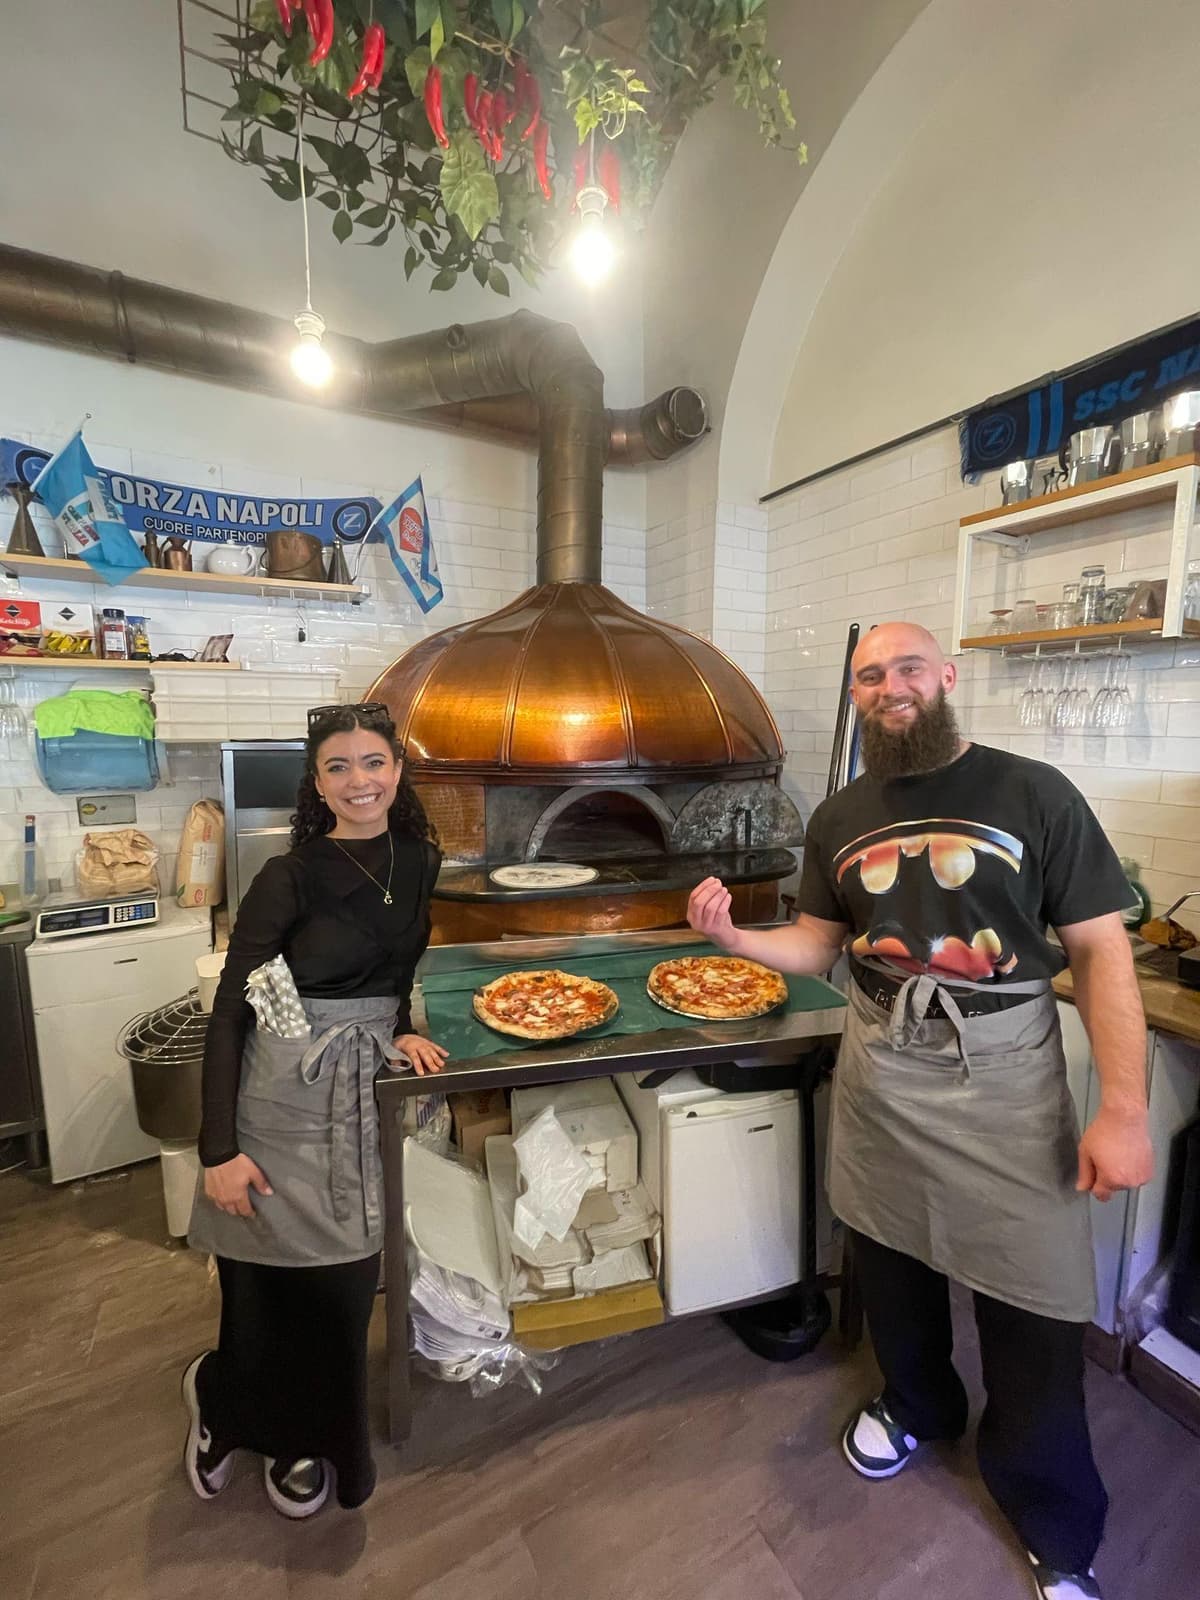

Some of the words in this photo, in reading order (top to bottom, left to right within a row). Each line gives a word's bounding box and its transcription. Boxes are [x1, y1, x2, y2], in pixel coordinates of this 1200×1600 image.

[1073, 370, 1148, 419] SSC
[98, 471, 210, 519] ORZA
[217, 496, 323, 527] NAPOLI
[144, 517, 193, 536] CUORE
[197, 525, 267, 543] PARTENOP
